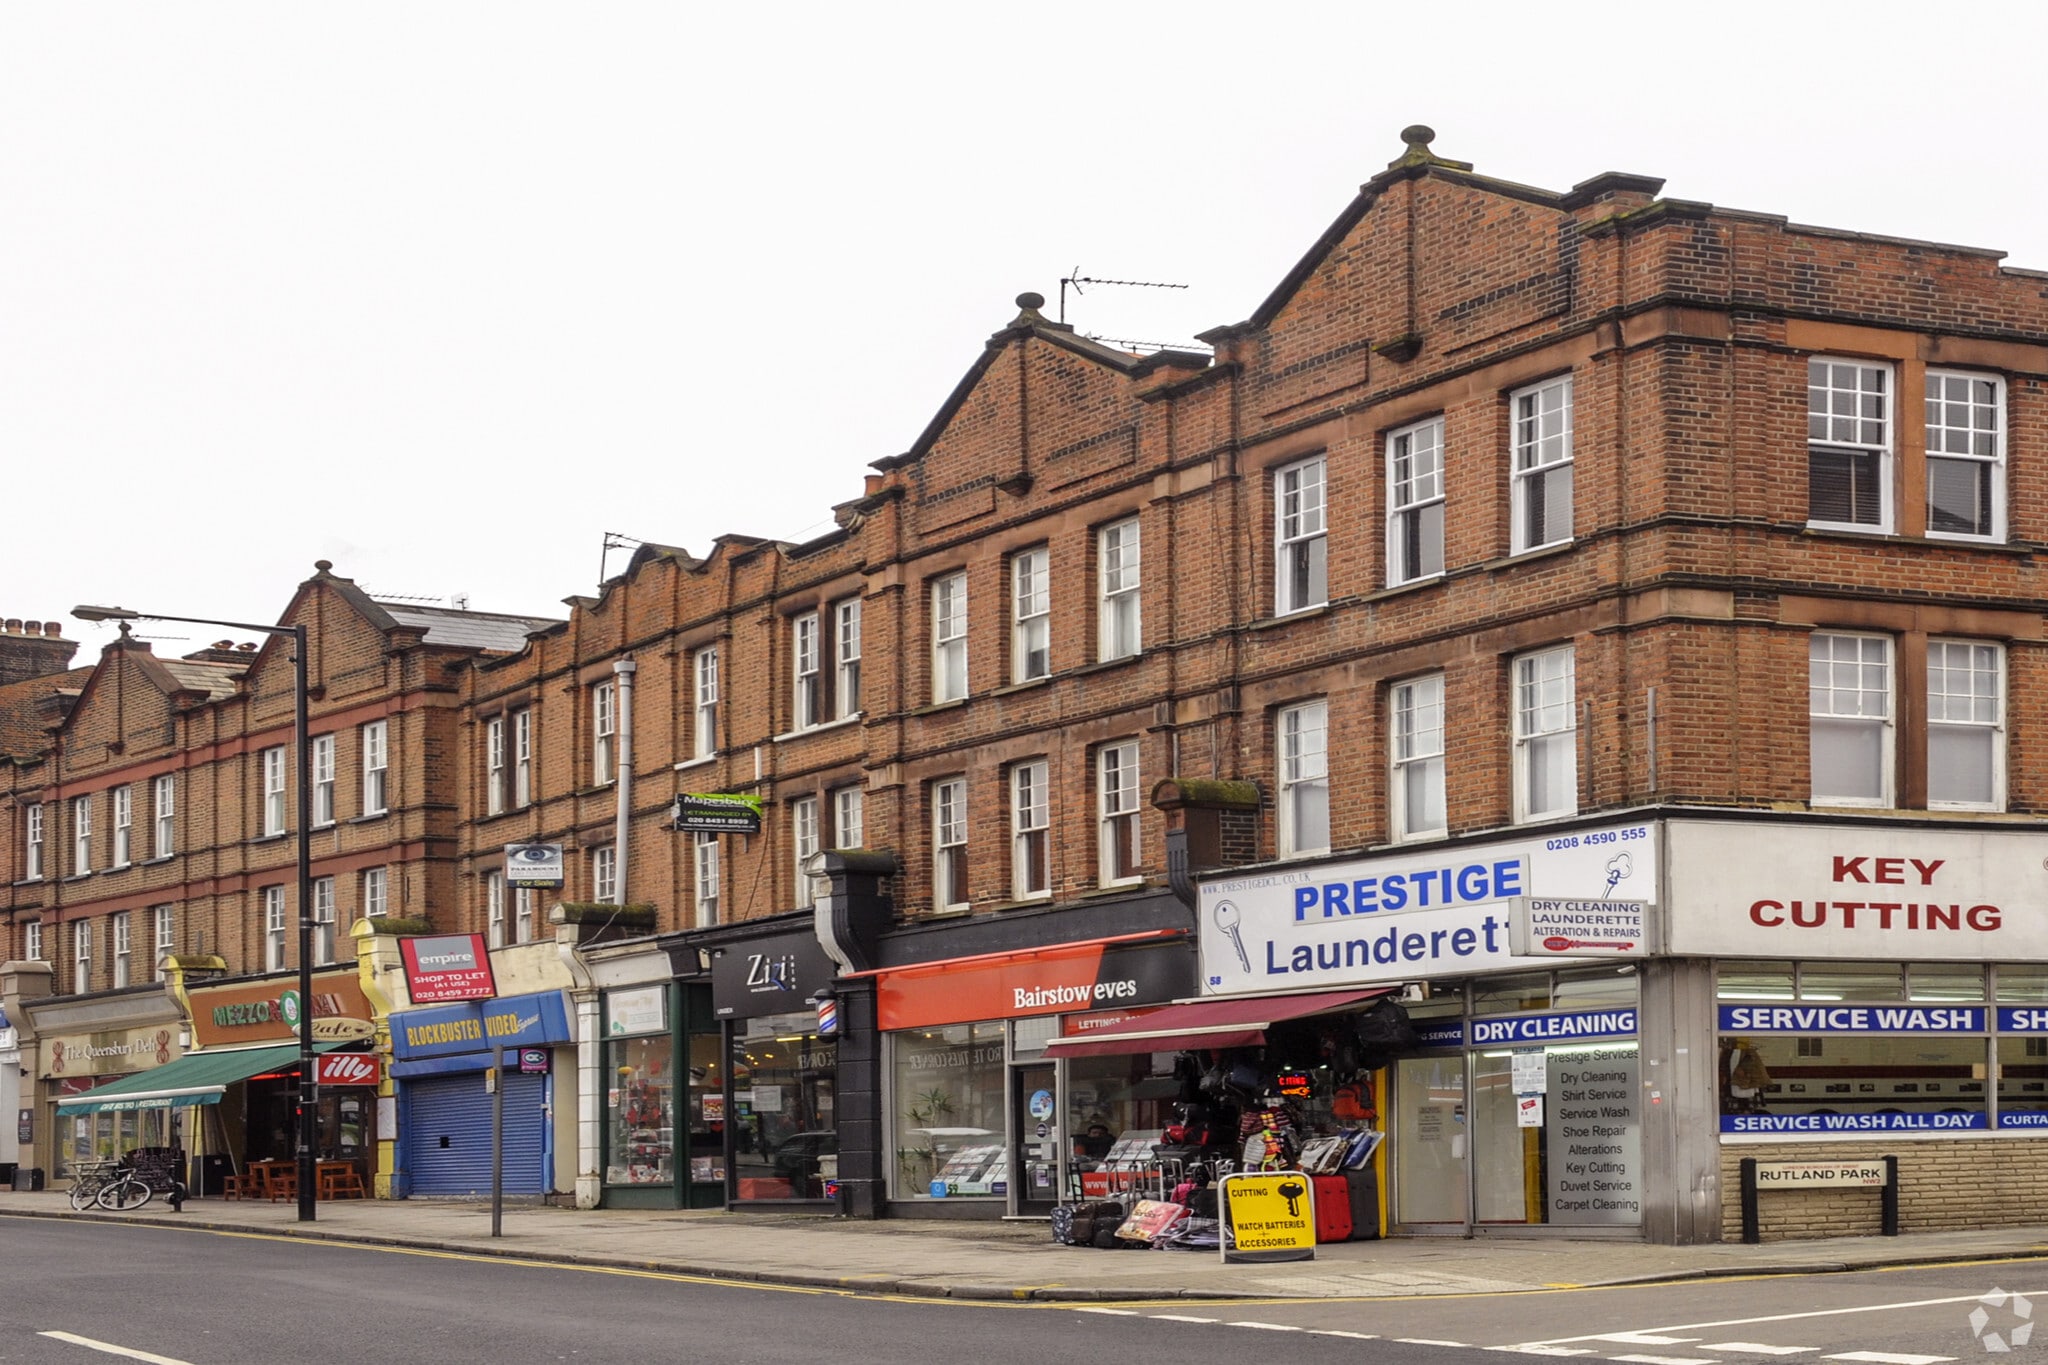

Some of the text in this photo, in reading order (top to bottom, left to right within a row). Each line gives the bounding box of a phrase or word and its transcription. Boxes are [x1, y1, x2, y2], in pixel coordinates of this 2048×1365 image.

[684, 796, 754, 807] Mapesbury
[1546, 827, 1647, 851] 0208 4590 555
[1832, 856, 1946, 885] KEY
[1295, 860, 1522, 922] PRESTIGE
[1531, 901, 1640, 913] DRY CLEANING
[1532, 914, 1641, 925] LAUNDERETTE
[1749, 900, 2002, 931] CUTTING
[1533, 927, 1641, 938] ALTERATION & REPAIRS
[1266, 916, 1510, 975] Launderet
[420, 951, 472, 965] empire
[414, 975, 444, 984] SHOP
[465, 972, 486, 980] LET
[1209, 976, 1222, 985] 58
[415, 991, 435, 999] 020
[437, 988, 462, 997] 8459
[464, 987, 490, 995] 7777
[1013, 980, 1137, 1008] Bairstow eves
[213, 1002, 269, 1026] MEZZO
[1731, 1009, 1972, 1029] SERVICE WASH
[407, 1019, 482, 1047] BLOCKBUSTER
[484, 1014, 517, 1037] VIDEO
[1474, 1013, 1635, 1041] DRY CLEANING
[1428, 1030, 1462, 1040] SERVICE
[65, 1038, 156, 1061] The Queensbury Deli
[1547, 1049, 1638, 1064] Prestige Services
[324, 1056, 373, 1082] illy
[1561, 1071, 1627, 1085] Dry Cleaning
[1562, 1089, 1626, 1101] Shirt Service
[1560, 1107, 1630, 1119] Service Wash
[1734, 1114, 1975, 1130] SERVICE WASH ALL DAY
[1563, 1125, 1626, 1138] Shoe Repair
[1568, 1144, 1622, 1155] Alterations
[1566, 1161, 1625, 1175] Key Cutting
[1760, 1169, 1880, 1180] RUTLAND PARK
[1231, 1188, 1268, 1197] CUTTING
[1560, 1180, 1632, 1192] Duvet Service
[1555, 1199, 1639, 1212] Carpet Cleaning
[1237, 1220, 1305, 1231] WATCH BATTERIES
[1239, 1238, 1296, 1248] ACCESSORIES
